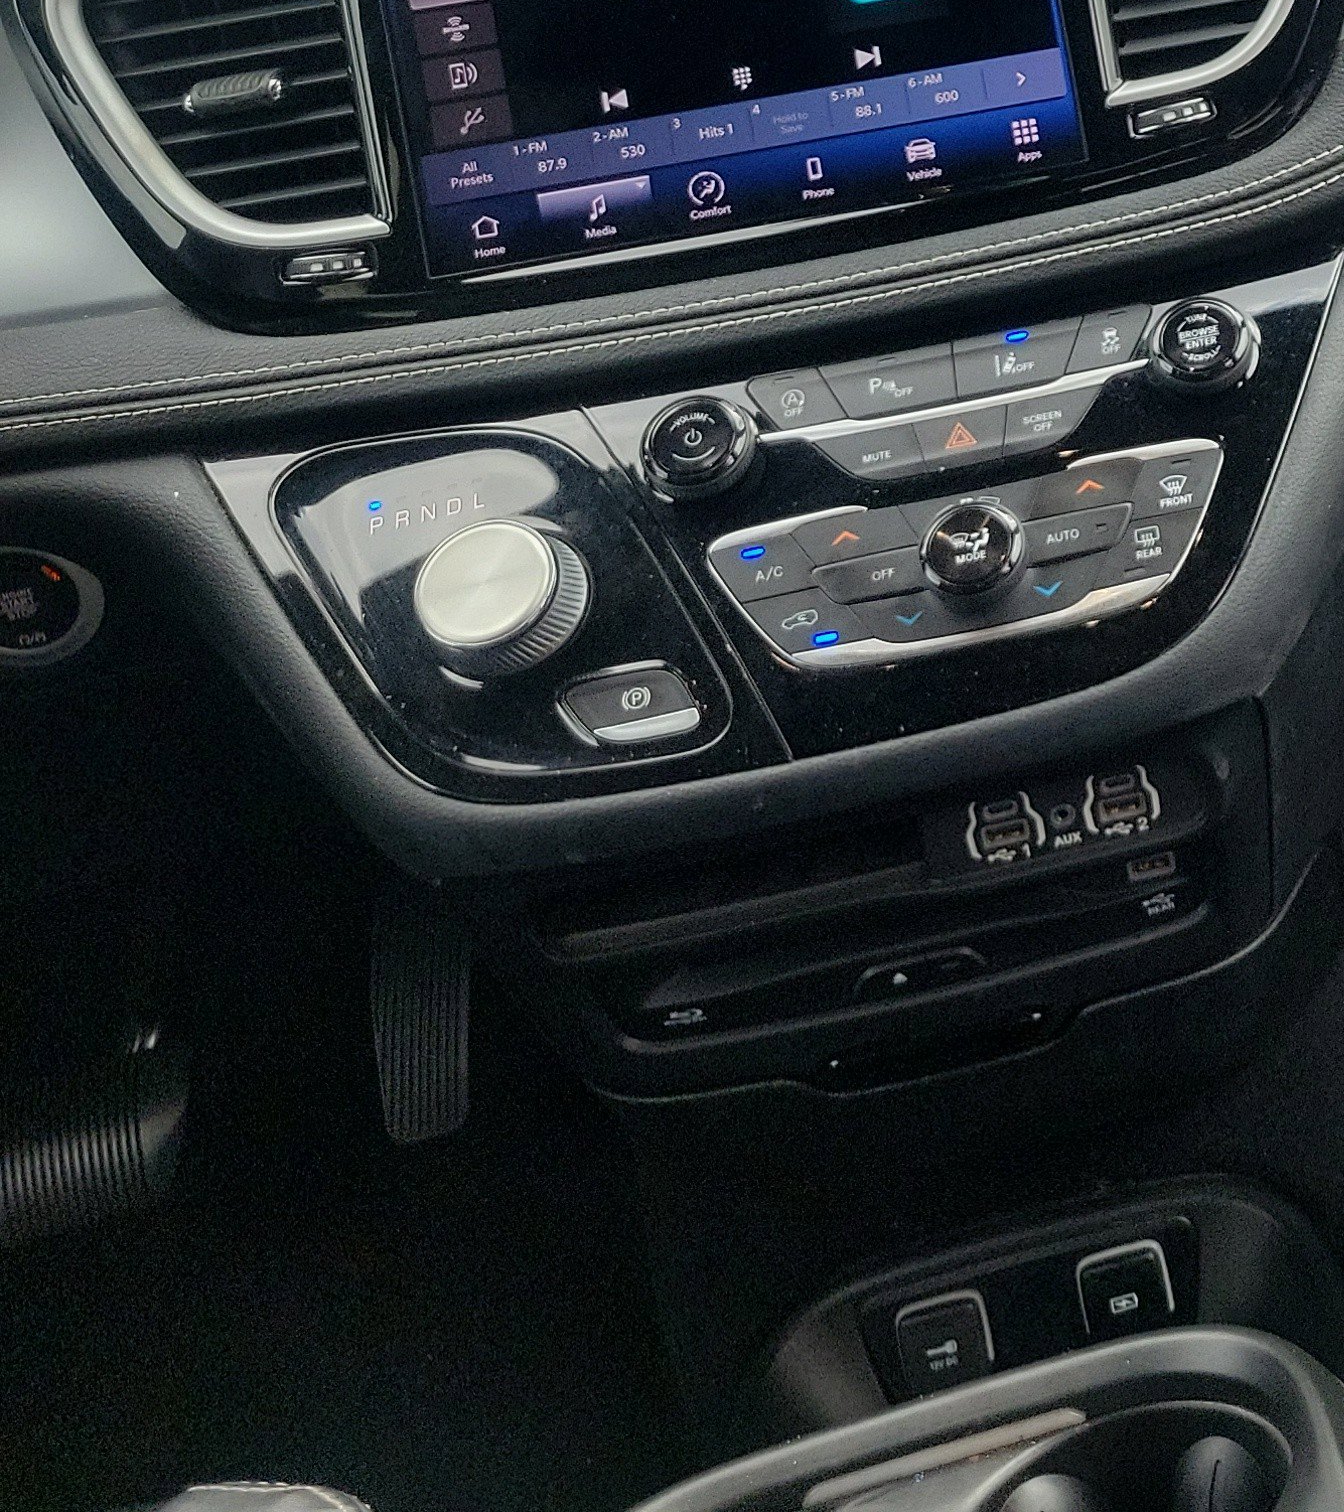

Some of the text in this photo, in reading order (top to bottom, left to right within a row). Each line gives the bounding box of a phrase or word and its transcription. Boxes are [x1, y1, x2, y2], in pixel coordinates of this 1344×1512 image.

[934, 90, 960, 104] 600
[751, 104, 761, 115] 4
[855, 103, 883, 118] 88.1
[672, 117, 682, 129] 3
[699, 125, 726, 140] Hits
[620, 144, 646, 159] 530
[1018, 149, 1043, 165] Apps
[461, 161, 478, 174] All
[537, 157, 568, 173] 87.9
[450, 172, 494, 189] Presets
[906, 166, 943, 182] Vehicle
[802, 185, 836, 200] Phone
[689, 204, 732, 221] Comfort
[585, 225, 618, 240] Media
[474, 244, 506, 260] Home
[1178, 324, 1220, 339] BROWSE
[1102, 345, 1121, 356] OFF
[1184, 336, 1217, 350] ENTER
[1015, 360, 1036, 373] OFF
[895, 385, 914, 398] OFF
[783, 405, 804, 418] OFF
[1022, 409, 1063, 426] SCREEN
[673, 411, 709, 428] VOLUME
[1033, 420, 1054, 433] OFF
[862, 449, 893, 463] MUTE
[1158, 492, 1194, 510] FRONT
[1046, 528, 1080, 545] AUTO
[955, 549, 988, 565] MODE
[1135, 545, 1163, 560] REAR
[754, 564, 784, 583] A/C
[871, 567, 896, 583] OFF
[1137, 816, 1150, 832] 2
[1053, 830, 1083, 848] AUX
[1022, 842, 1032, 858] 1
